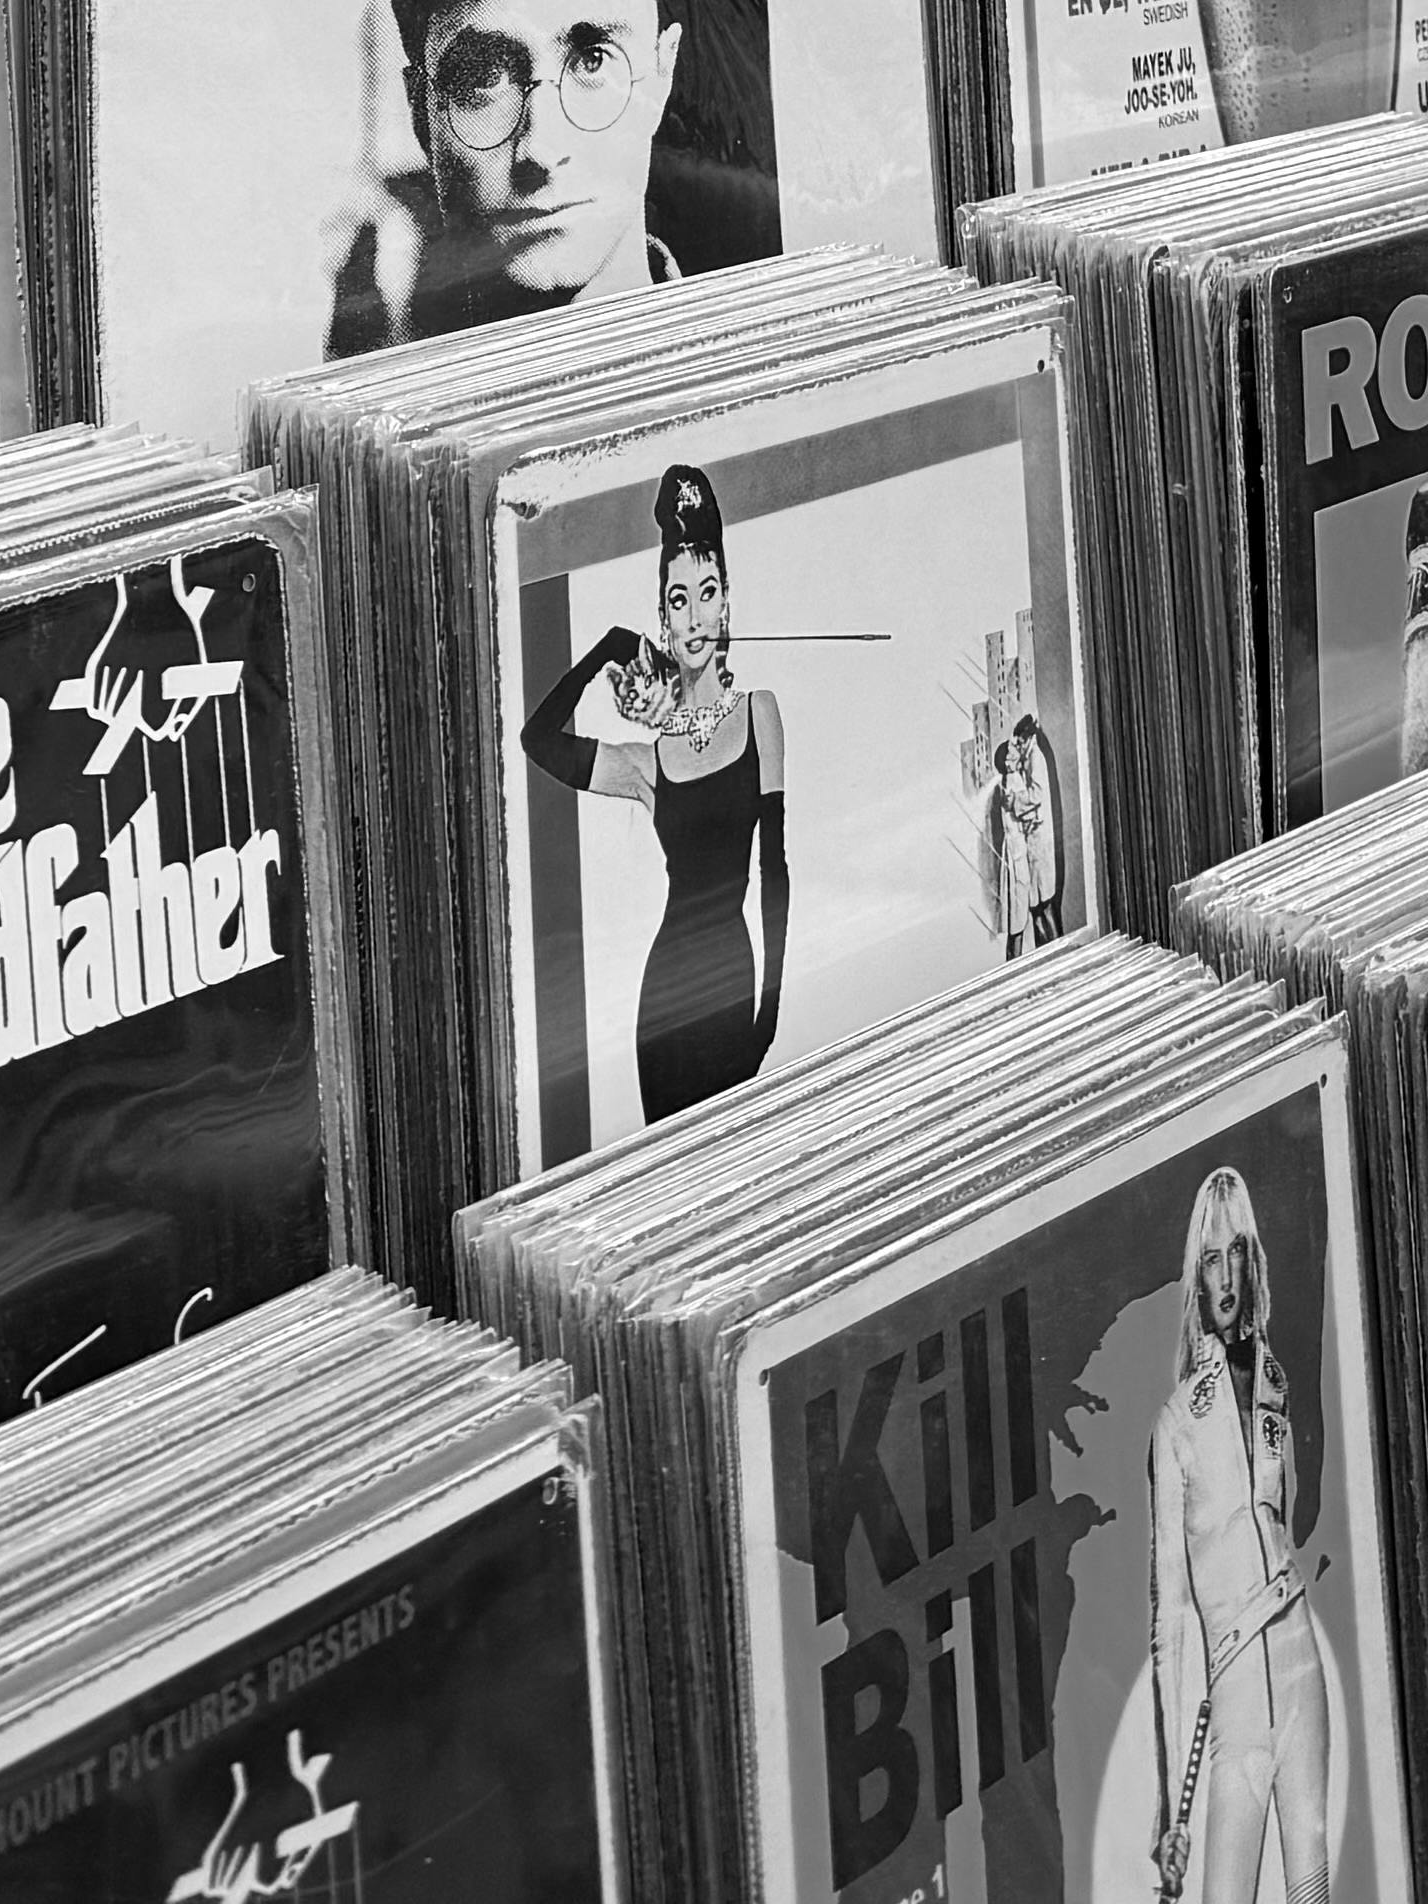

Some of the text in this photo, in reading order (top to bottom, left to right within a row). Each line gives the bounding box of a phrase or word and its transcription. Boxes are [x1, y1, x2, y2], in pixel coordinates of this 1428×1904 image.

[805, 1286, 1047, 1626] Kill
[107, 1669, 261, 1794] PICTURES
[267, 1585, 417, 1704] PRESENTS
[820, 1537, 1047, 1893] Bill
